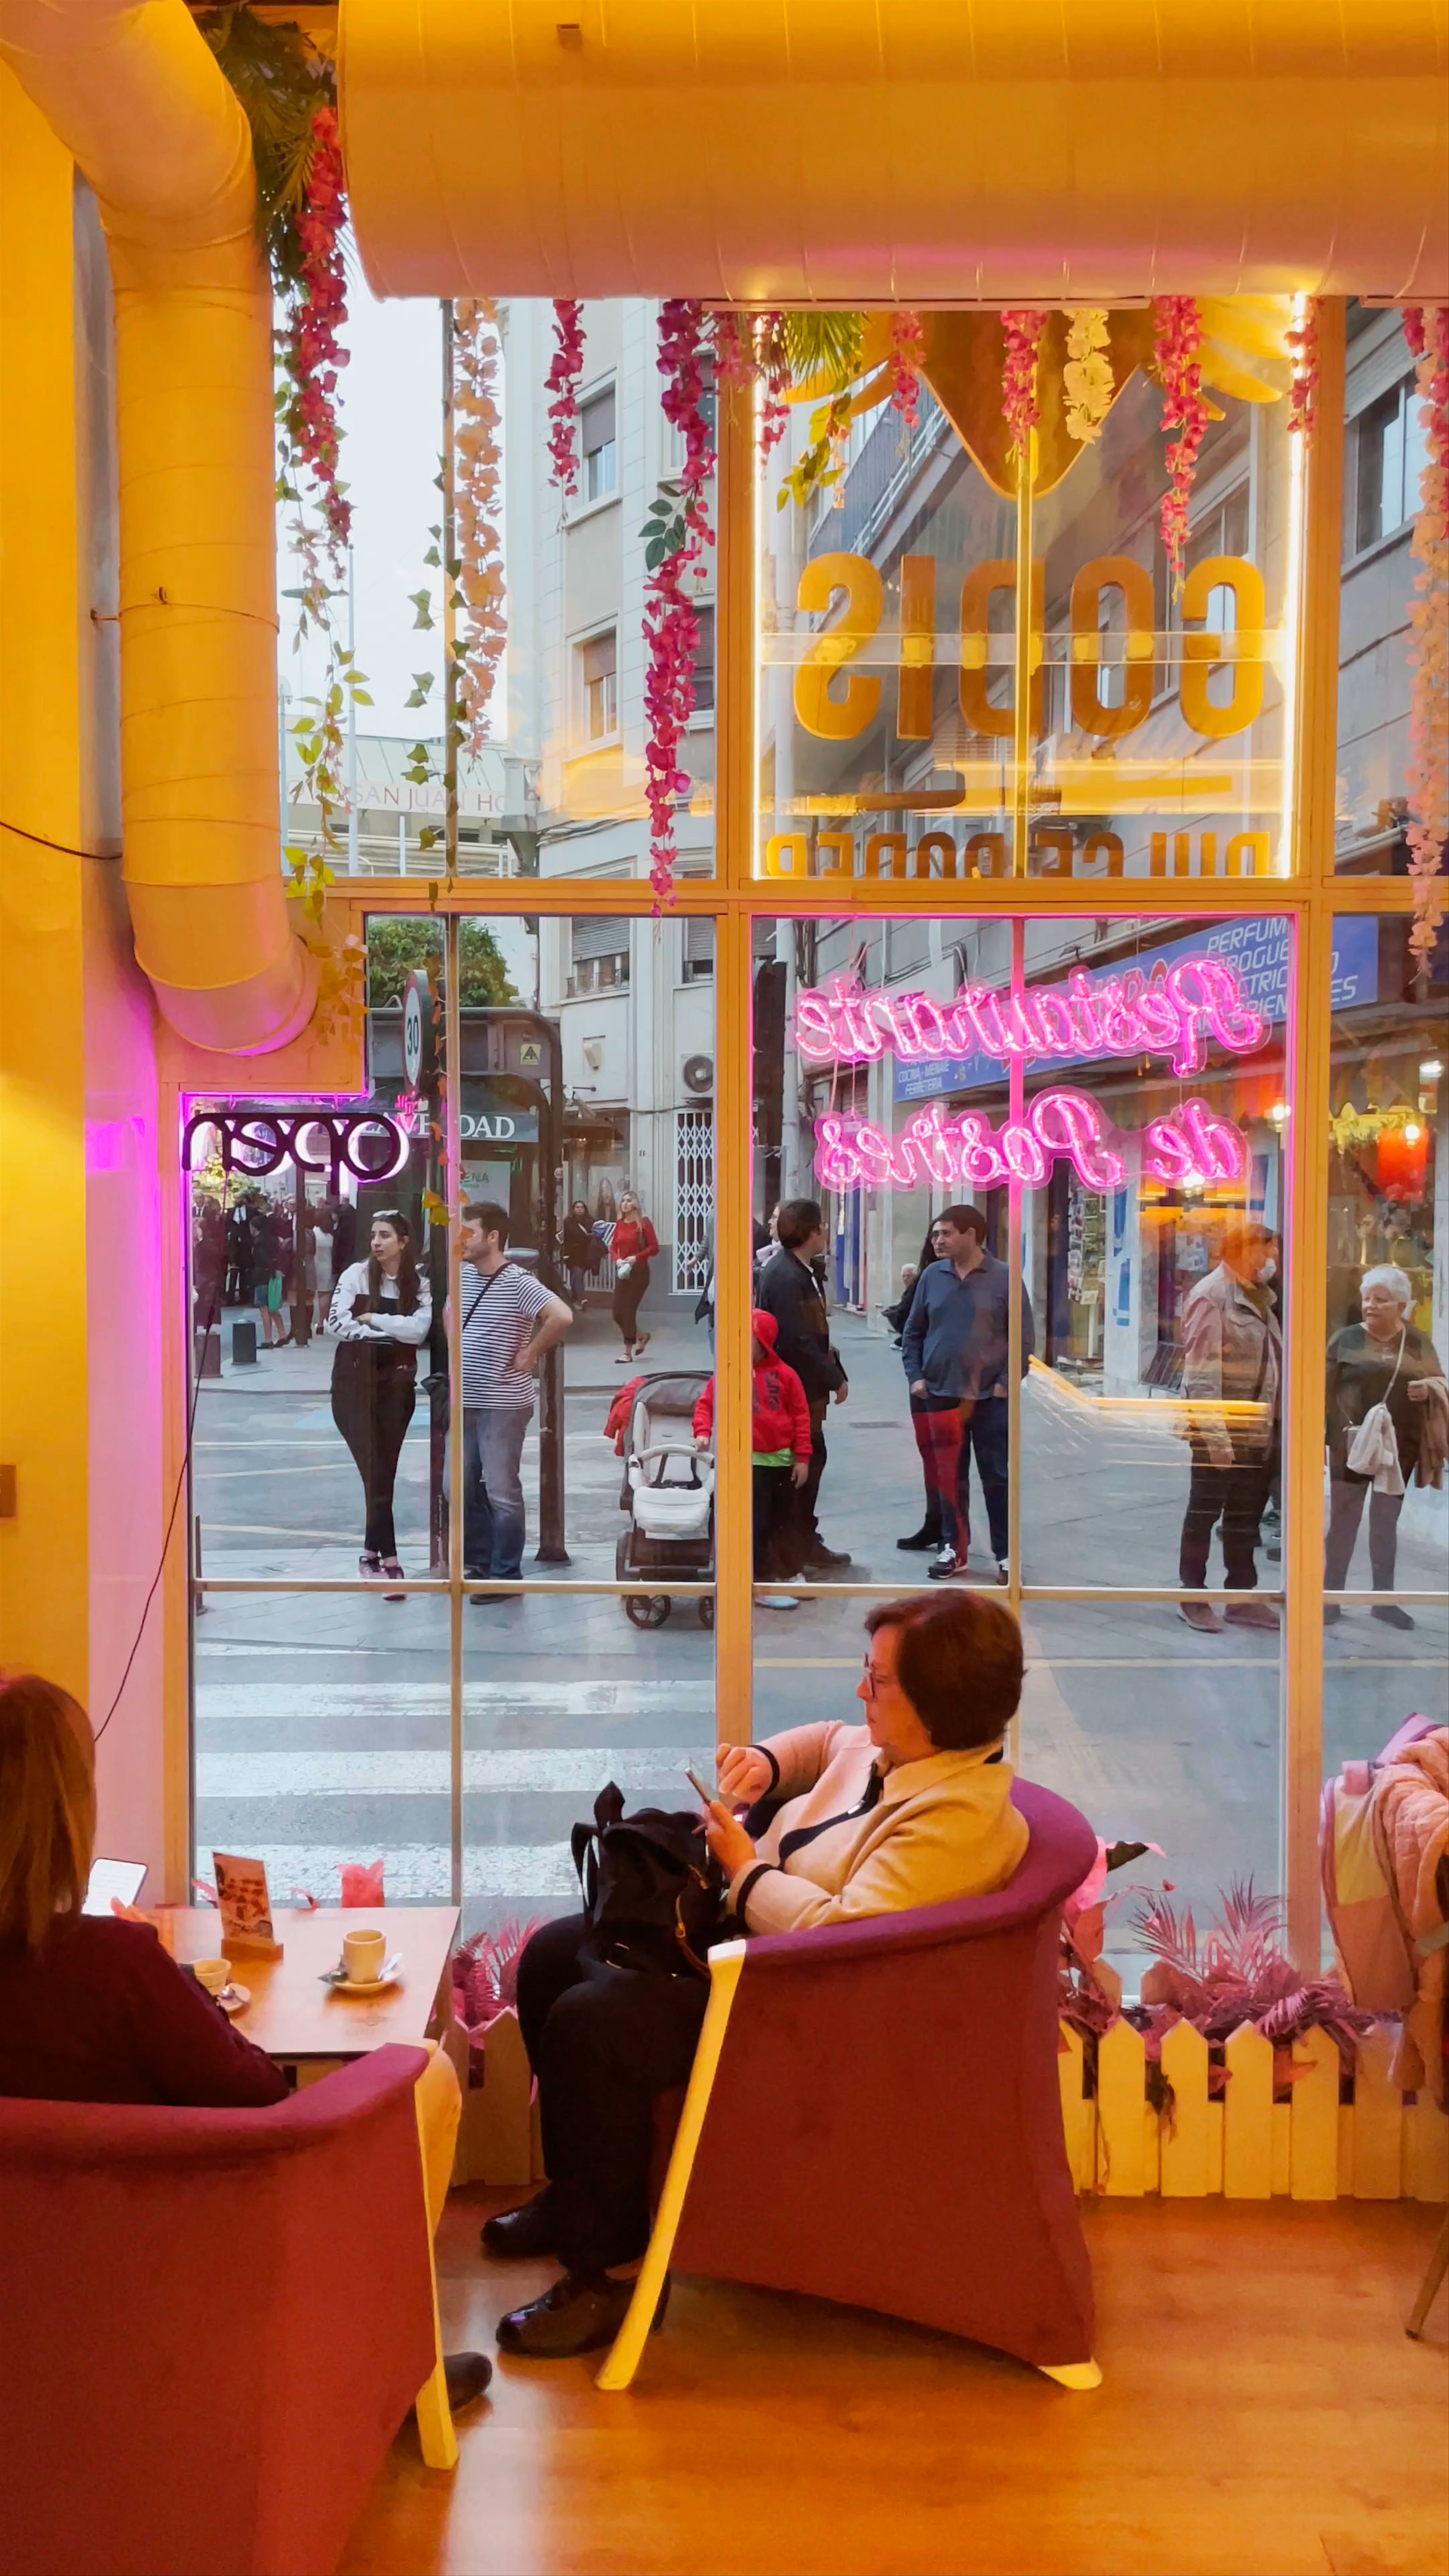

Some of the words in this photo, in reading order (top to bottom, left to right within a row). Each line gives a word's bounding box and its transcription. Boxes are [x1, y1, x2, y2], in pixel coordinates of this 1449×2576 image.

[1208, 917, 1288, 957] PERFUM
[407, 1015, 419, 1056] 30
[397, 1112, 516, 1139] VEDAD
